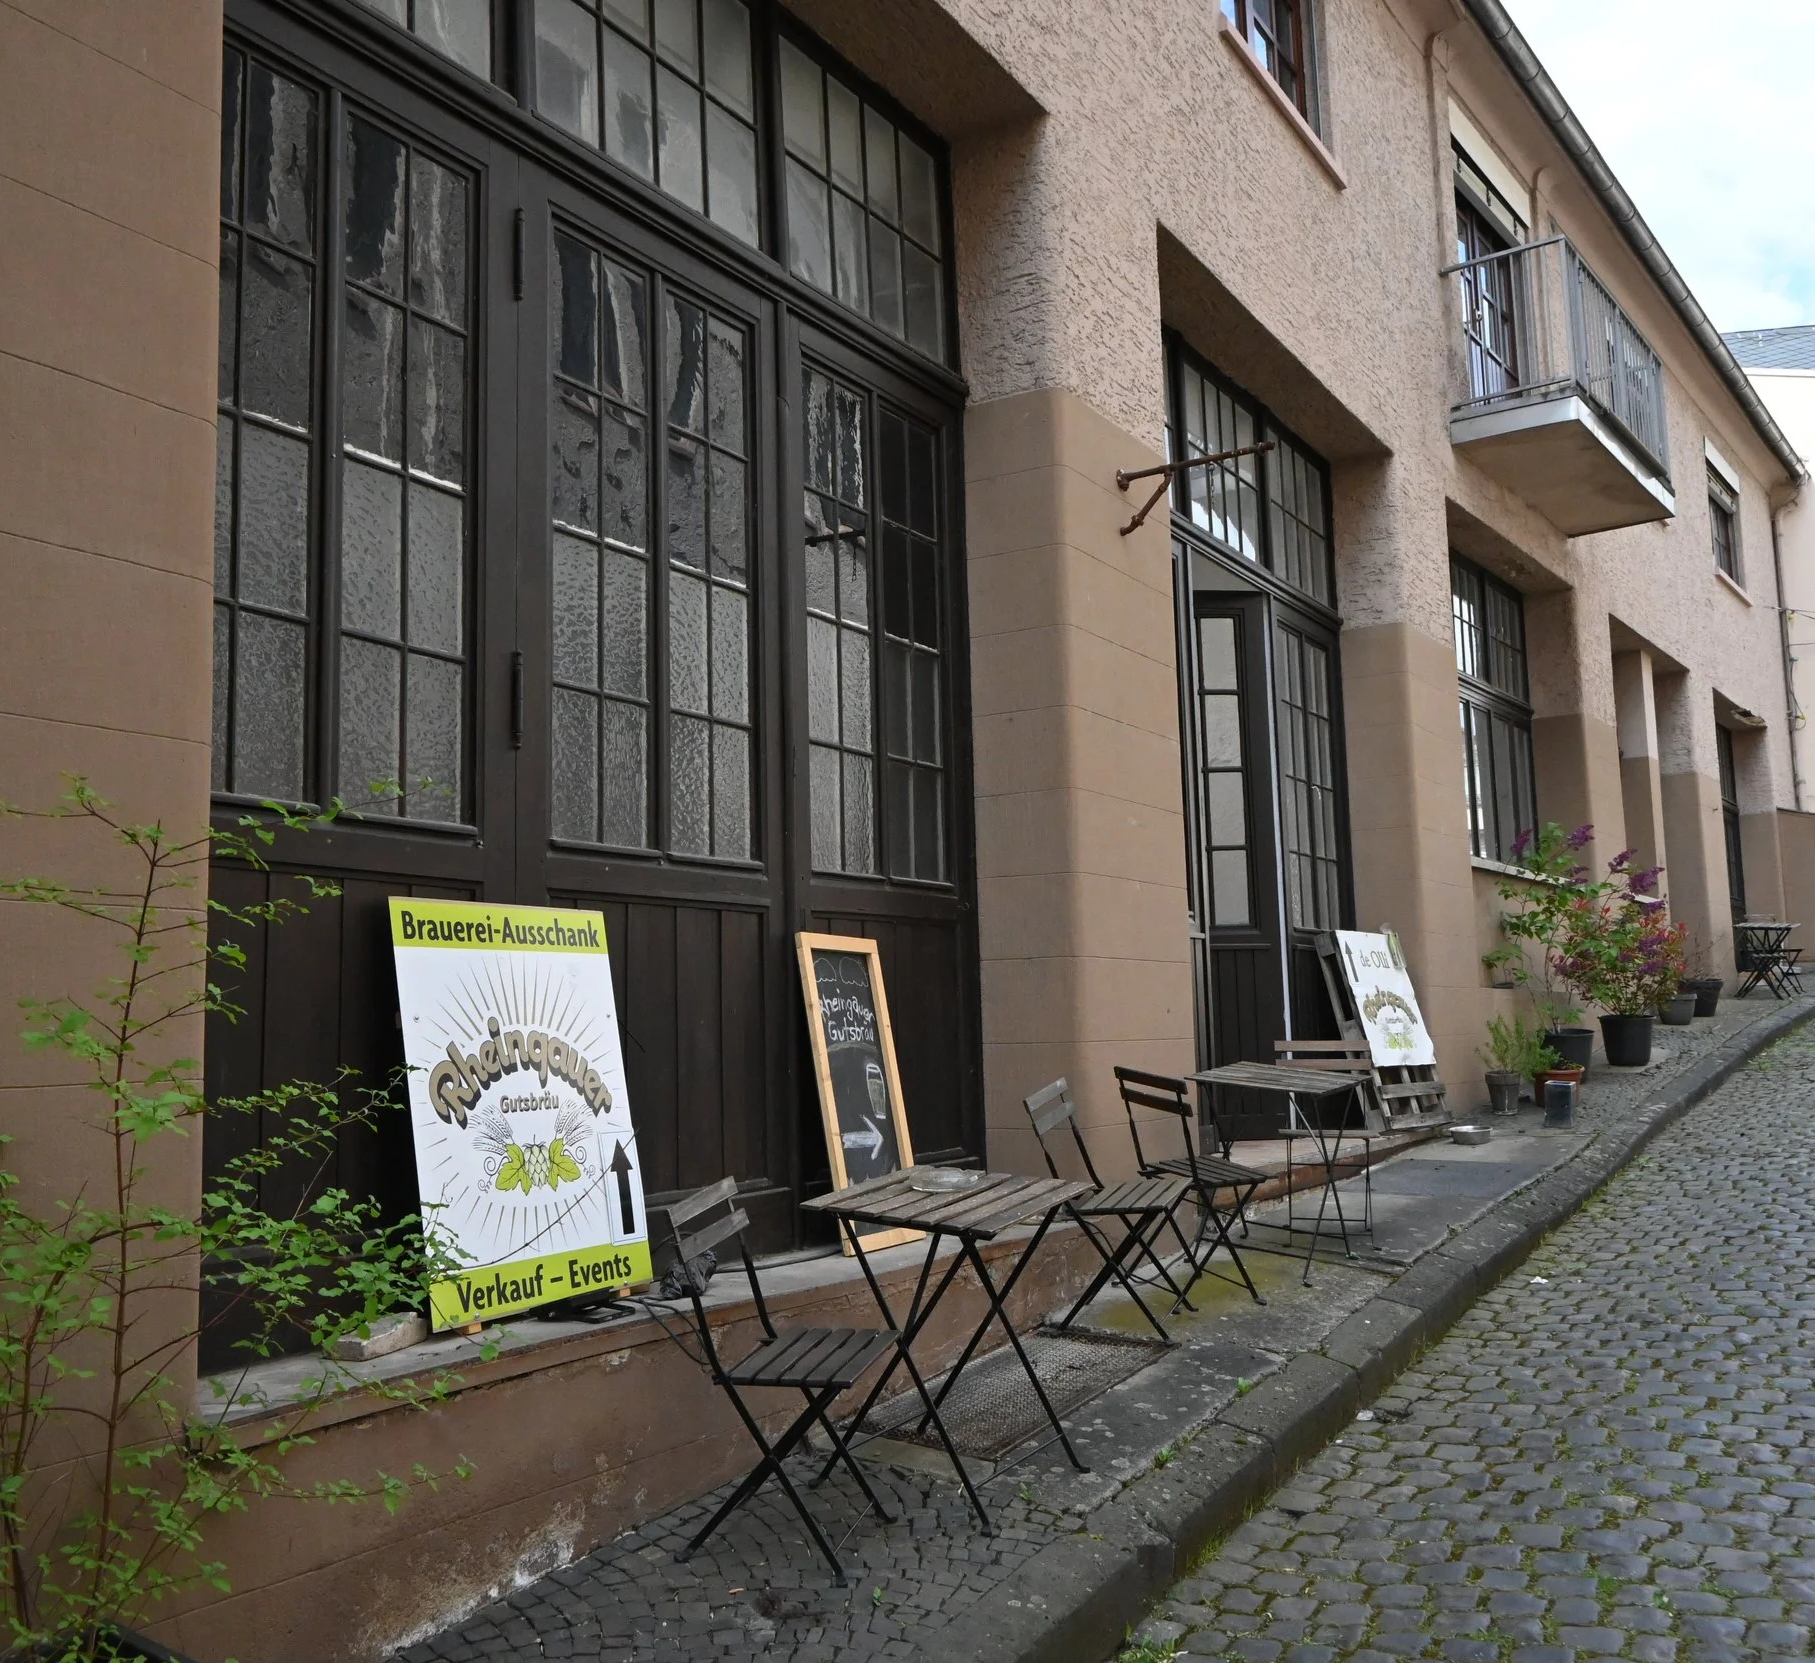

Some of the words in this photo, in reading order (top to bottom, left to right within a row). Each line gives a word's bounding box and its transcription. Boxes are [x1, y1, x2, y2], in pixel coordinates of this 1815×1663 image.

[401, 909, 600, 949] Brauerei-Ausschank
[428, 1016, 612, 1130] Rheingauer
[500, 1092, 559, 1114] Gutsbräu
[457, 1263, 544, 1314] Verkauf
[568, 1252, 632, 1287] Events
